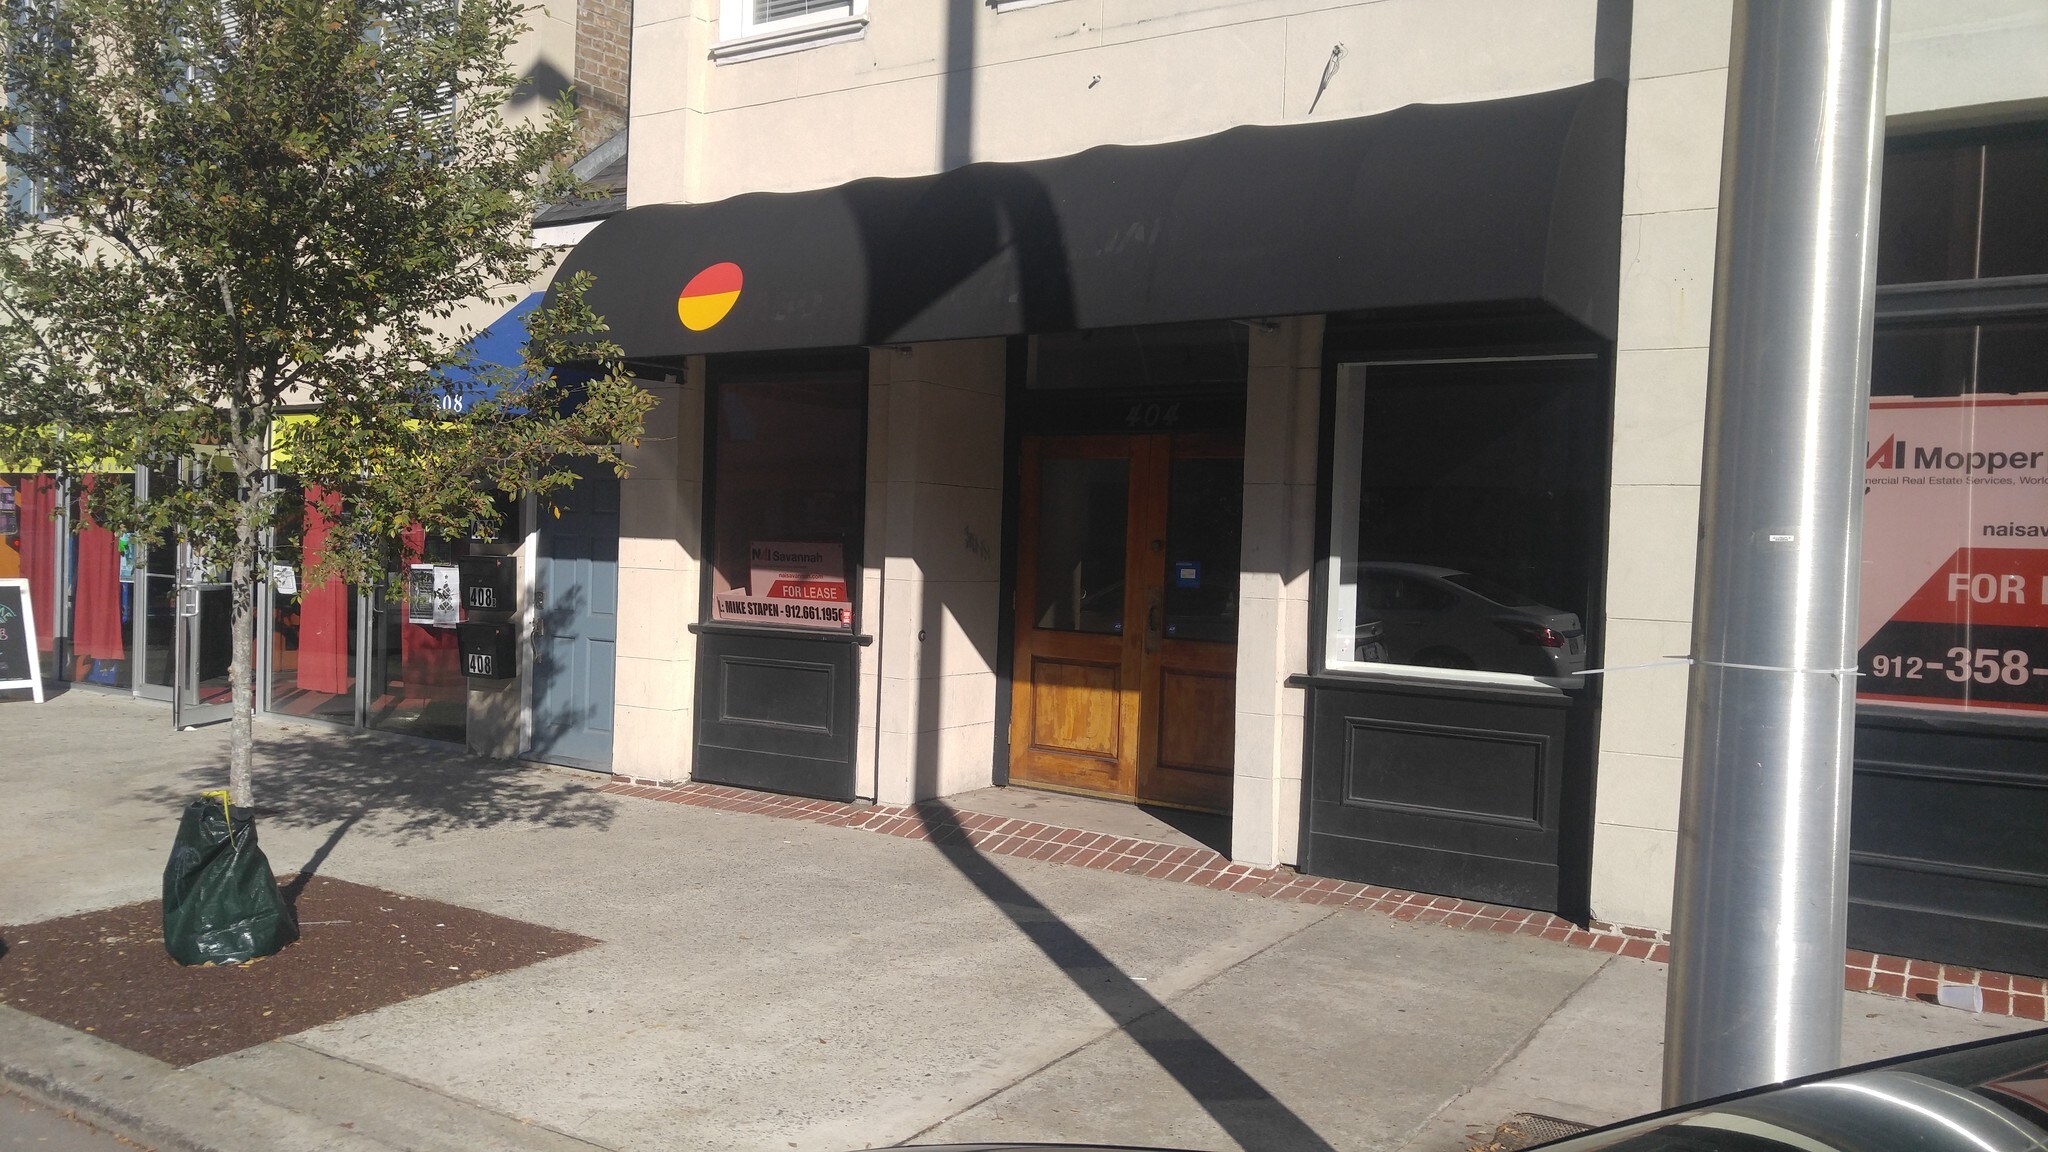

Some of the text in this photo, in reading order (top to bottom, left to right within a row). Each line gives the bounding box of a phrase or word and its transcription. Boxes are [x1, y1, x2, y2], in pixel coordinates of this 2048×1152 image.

[1125, 402, 1181, 427] 404
[1914, 447, 2044, 475] Mopper
[1902, 476, 1926, 485] Real
[1929, 476, 1963, 485] Estate
[1966, 476, 2016, 486] Services,
[772, 550, 823, 563] Savannah
[782, 585, 837, 600] FOR LEASE
[1948, 573, 2026, 605] FOR
[725, 600, 747, 615] MIKE
[748, 602, 779, 617] STAPEN
[469, 656, 491, 674] 408
